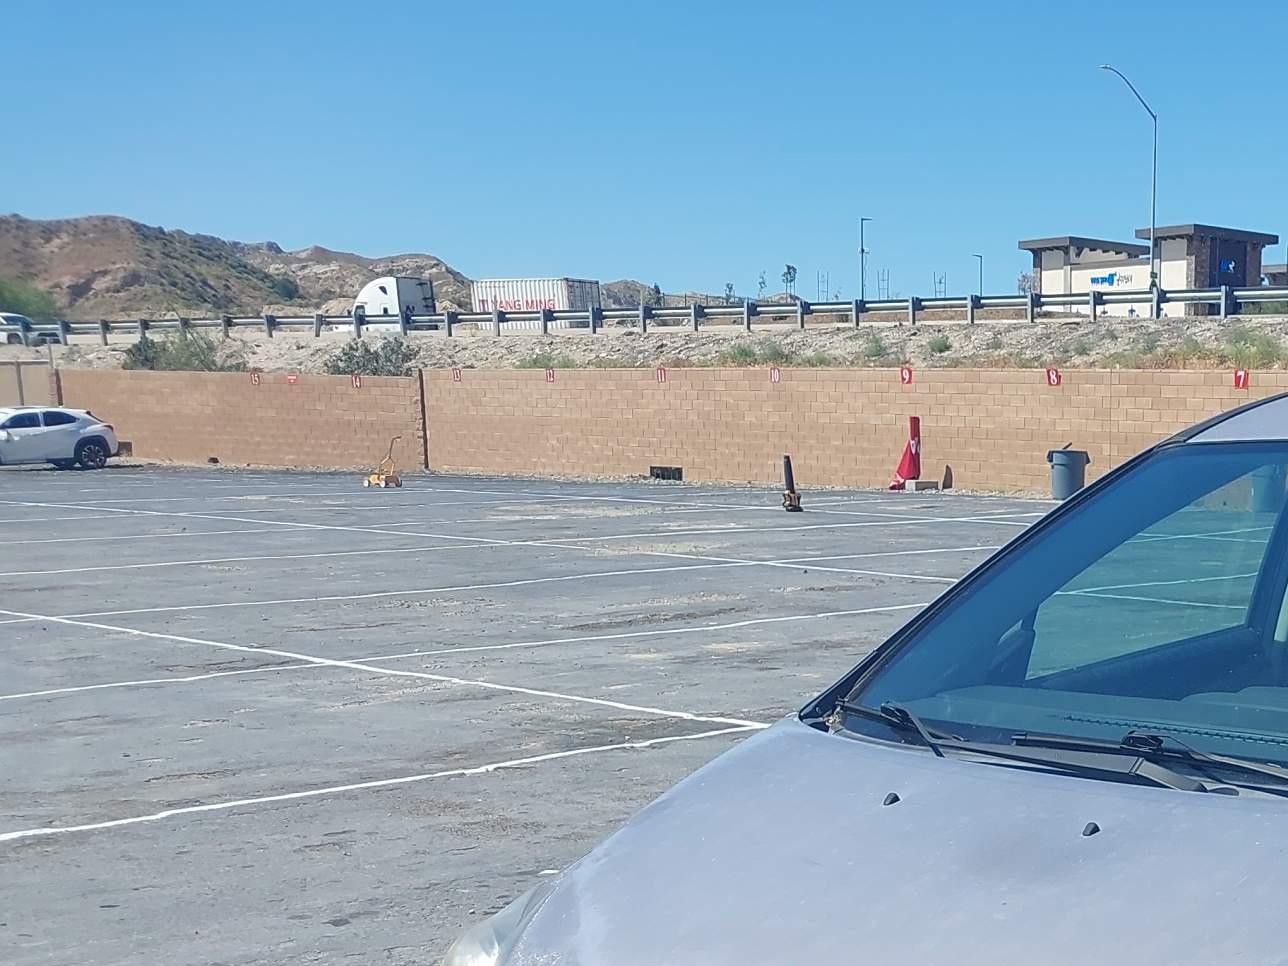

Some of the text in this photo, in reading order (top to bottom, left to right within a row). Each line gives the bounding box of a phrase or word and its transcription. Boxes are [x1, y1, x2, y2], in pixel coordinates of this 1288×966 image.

[525, 299, 555, 311] MING
[251, 373, 259, 385] 15
[352, 375, 360, 389] 14
[657, 369, 666, 382] 11
[770, 369, 779, 382] 10
[902, 369, 910, 383] 9
[1050, 368, 1058, 385] 8
[1236, 370, 1245, 388] 7
